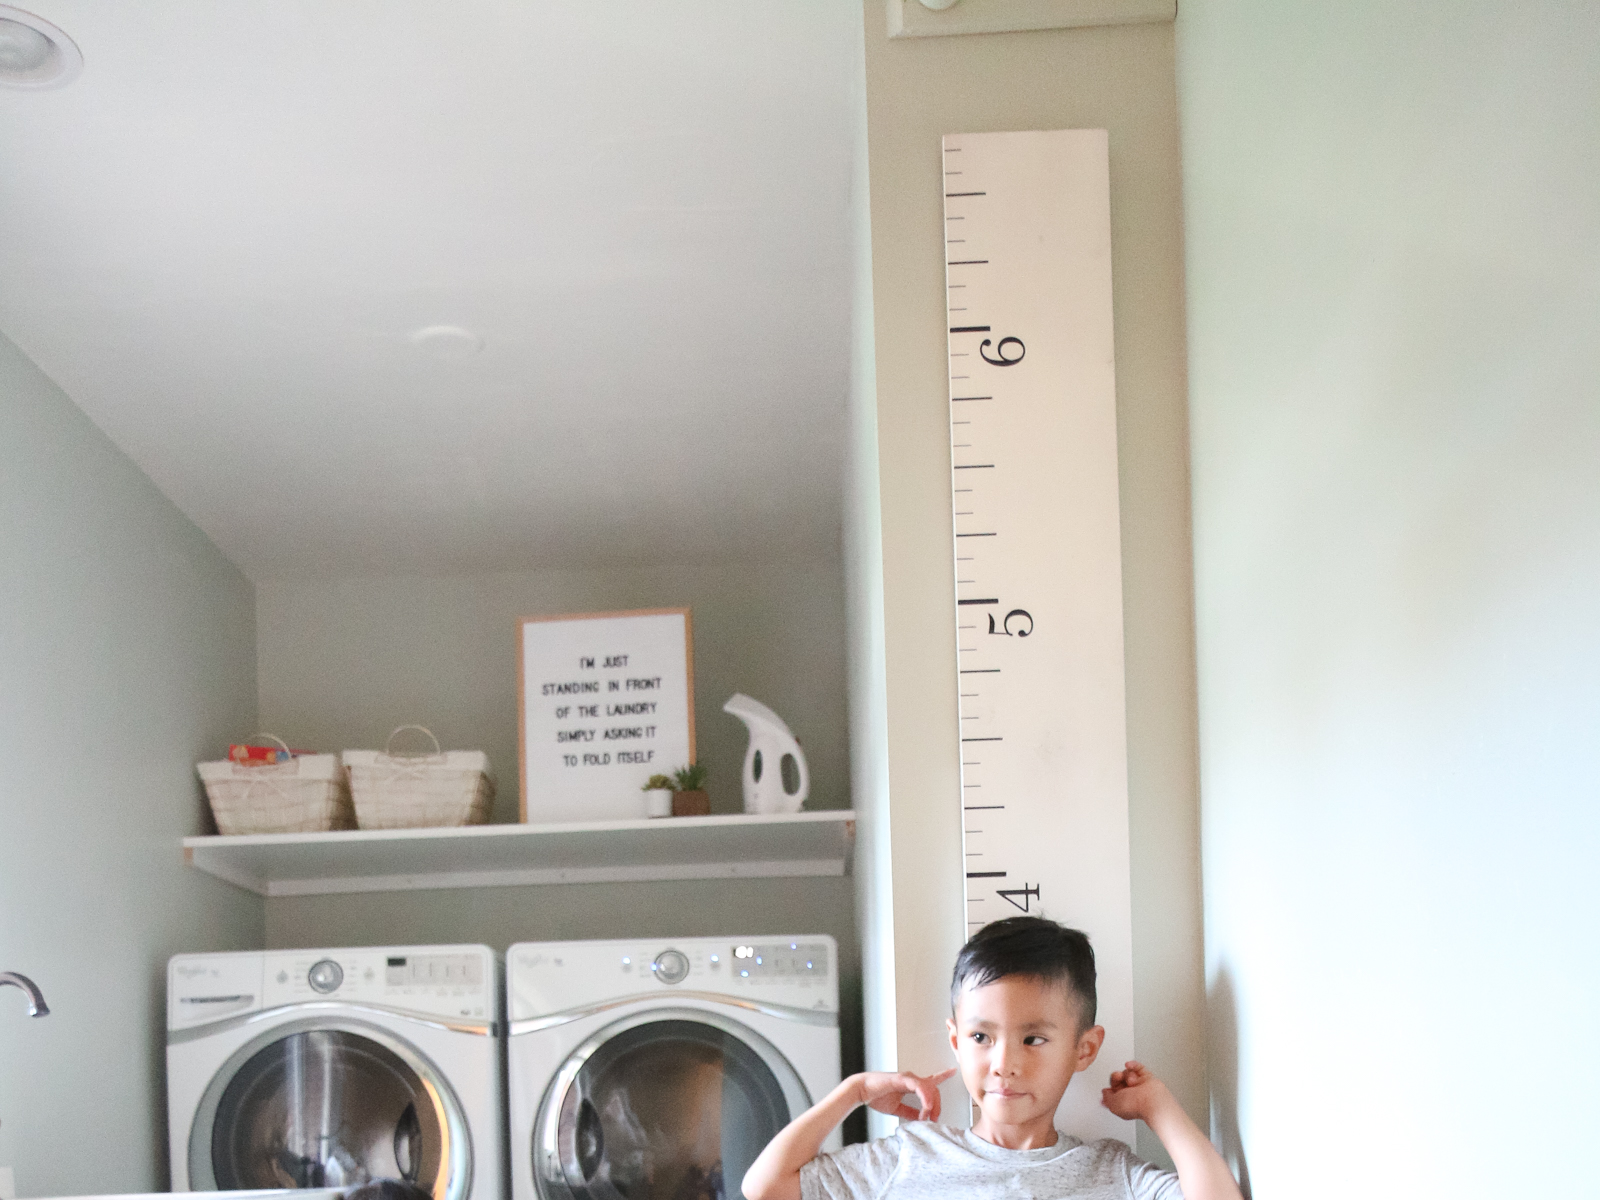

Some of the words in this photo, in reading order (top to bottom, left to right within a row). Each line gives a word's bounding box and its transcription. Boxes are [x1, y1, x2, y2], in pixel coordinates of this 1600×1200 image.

[979, 336, 1026, 367] 6
[988, 608, 1034, 637] 5
[580, 656, 595, 670] I'M
[602, 655, 629, 668] JUST
[542, 682, 600, 696] STANDING
[608, 680, 620, 693] IN
[626, 678, 662, 691] FRONT
[556, 706, 571, 719] OF
[578, 705, 598, 718] THE
[606, 702, 657, 716] LAUNDRY
[557, 729, 596, 743] SIMPLY
[604, 727, 642, 741] ASKING
[646, 726, 657, 738] IT
[563, 754, 578, 767] TO
[583, 752, 611, 766] FOLD
[617, 750, 655, 764] ITSELF
[996, 882, 1040, 913] 4
